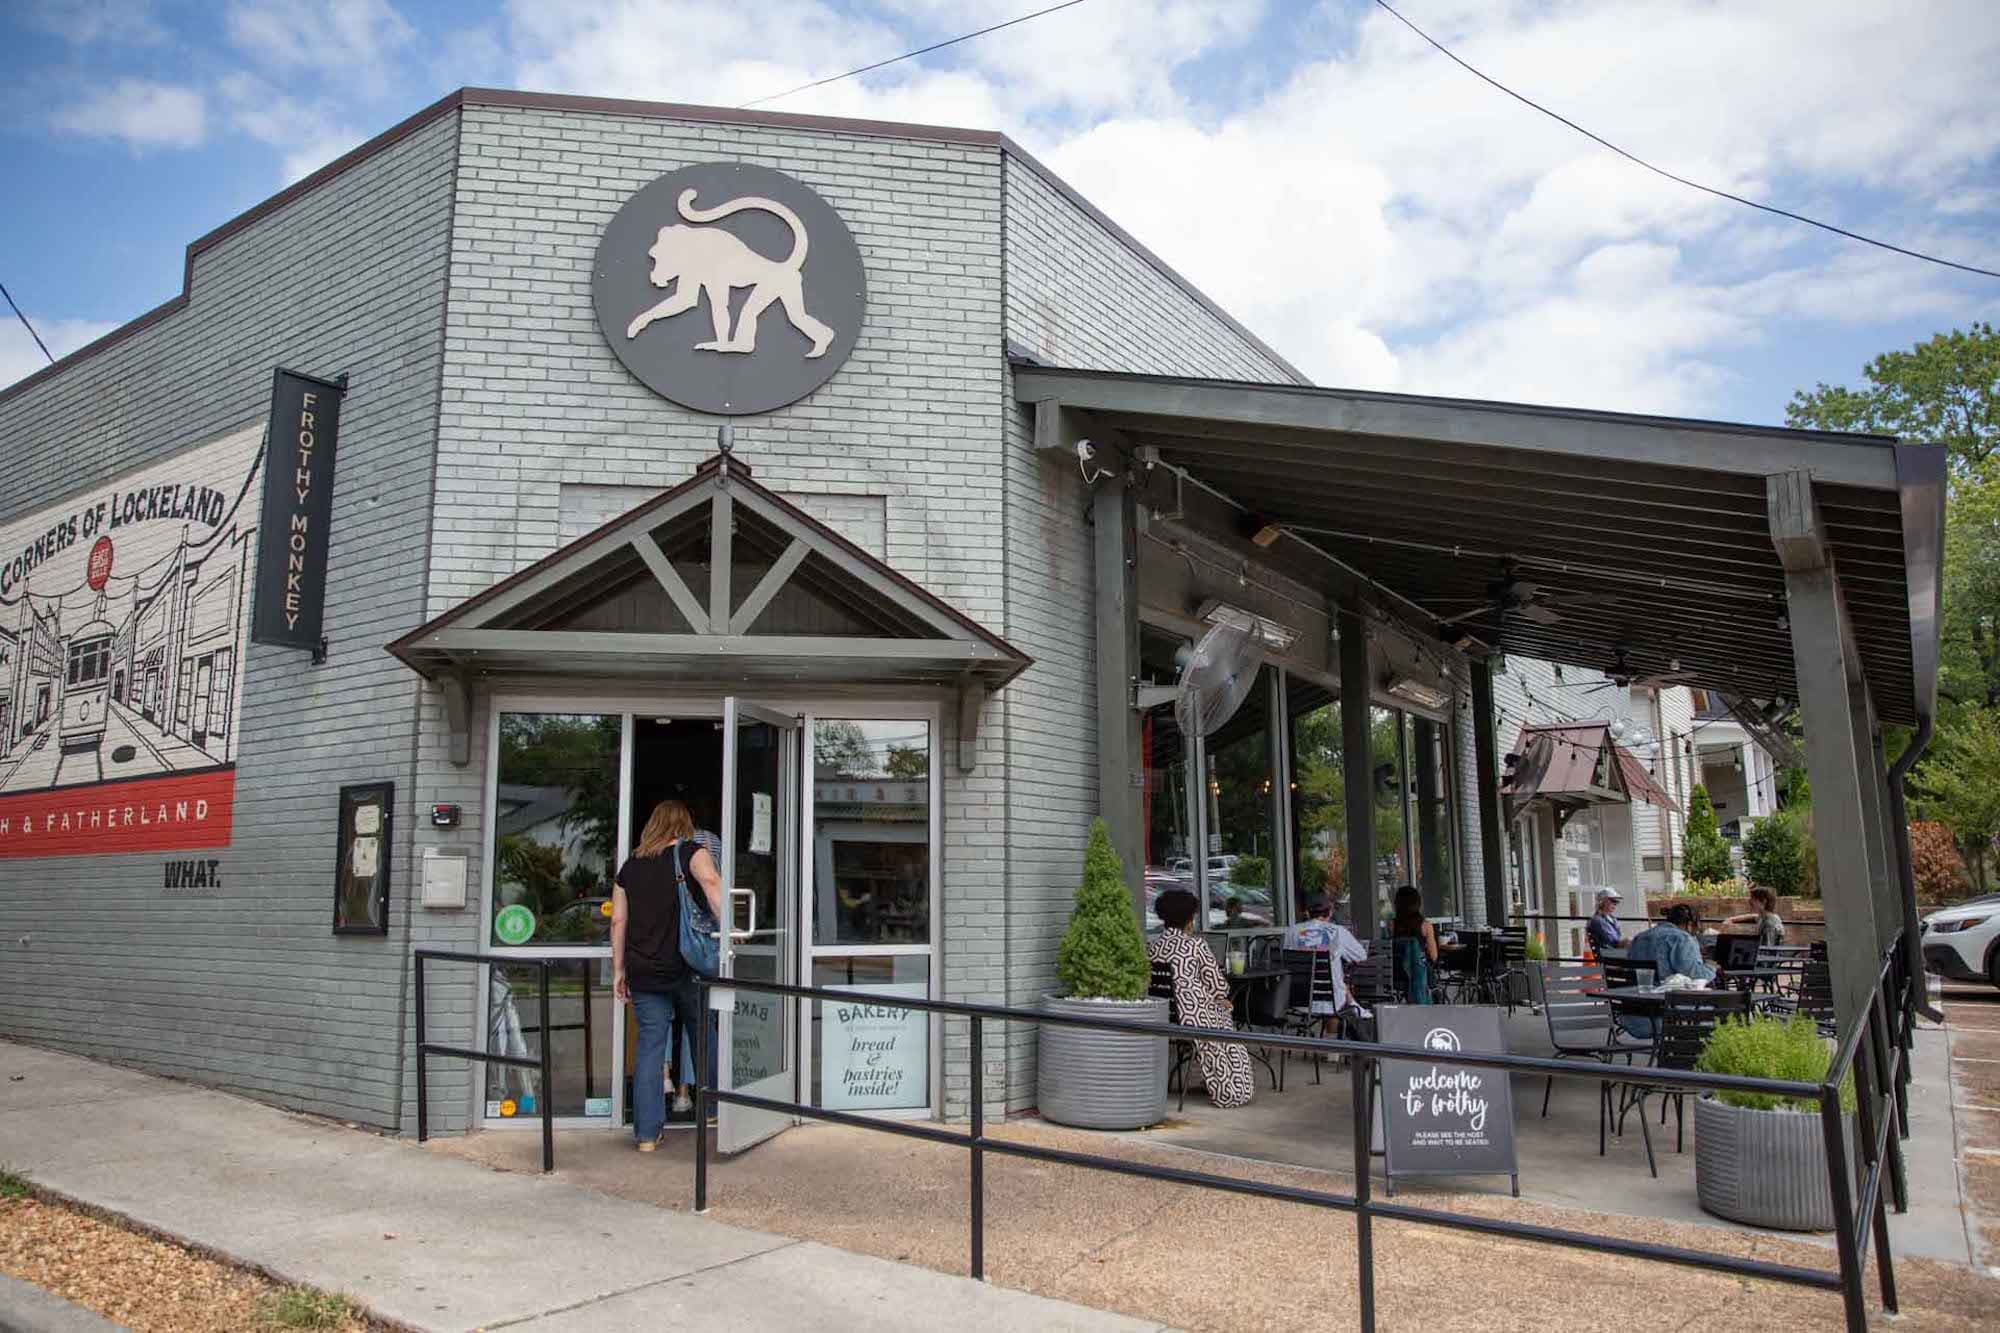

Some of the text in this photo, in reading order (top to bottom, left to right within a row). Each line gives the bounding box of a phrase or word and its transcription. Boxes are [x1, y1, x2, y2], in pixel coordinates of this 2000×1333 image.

[285, 392, 317, 631] FROTHY MONKEY
[1, 514, 78, 595] CORNERS
[83, 502, 106, 538] OF
[109, 484, 226, 528] LOCKELAND
[23, 815, 32, 833] &
[46, 799, 208, 833] FATHERLAND
[164, 860, 221, 889] WHAT.
[837, 1003, 910, 1023] BAKERY
[851, 1036, 896, 1052] bread
[866, 1053, 881, 1066] &
[843, 1067, 904, 1084] pastries
[1409, 1066, 1482, 1091] welcome
[847, 1082, 899, 1096] inside!
[1400, 1088, 1488, 1131] to frothy
[1415, 1131, 1484, 1139] PLEASE SEE THE HOST
